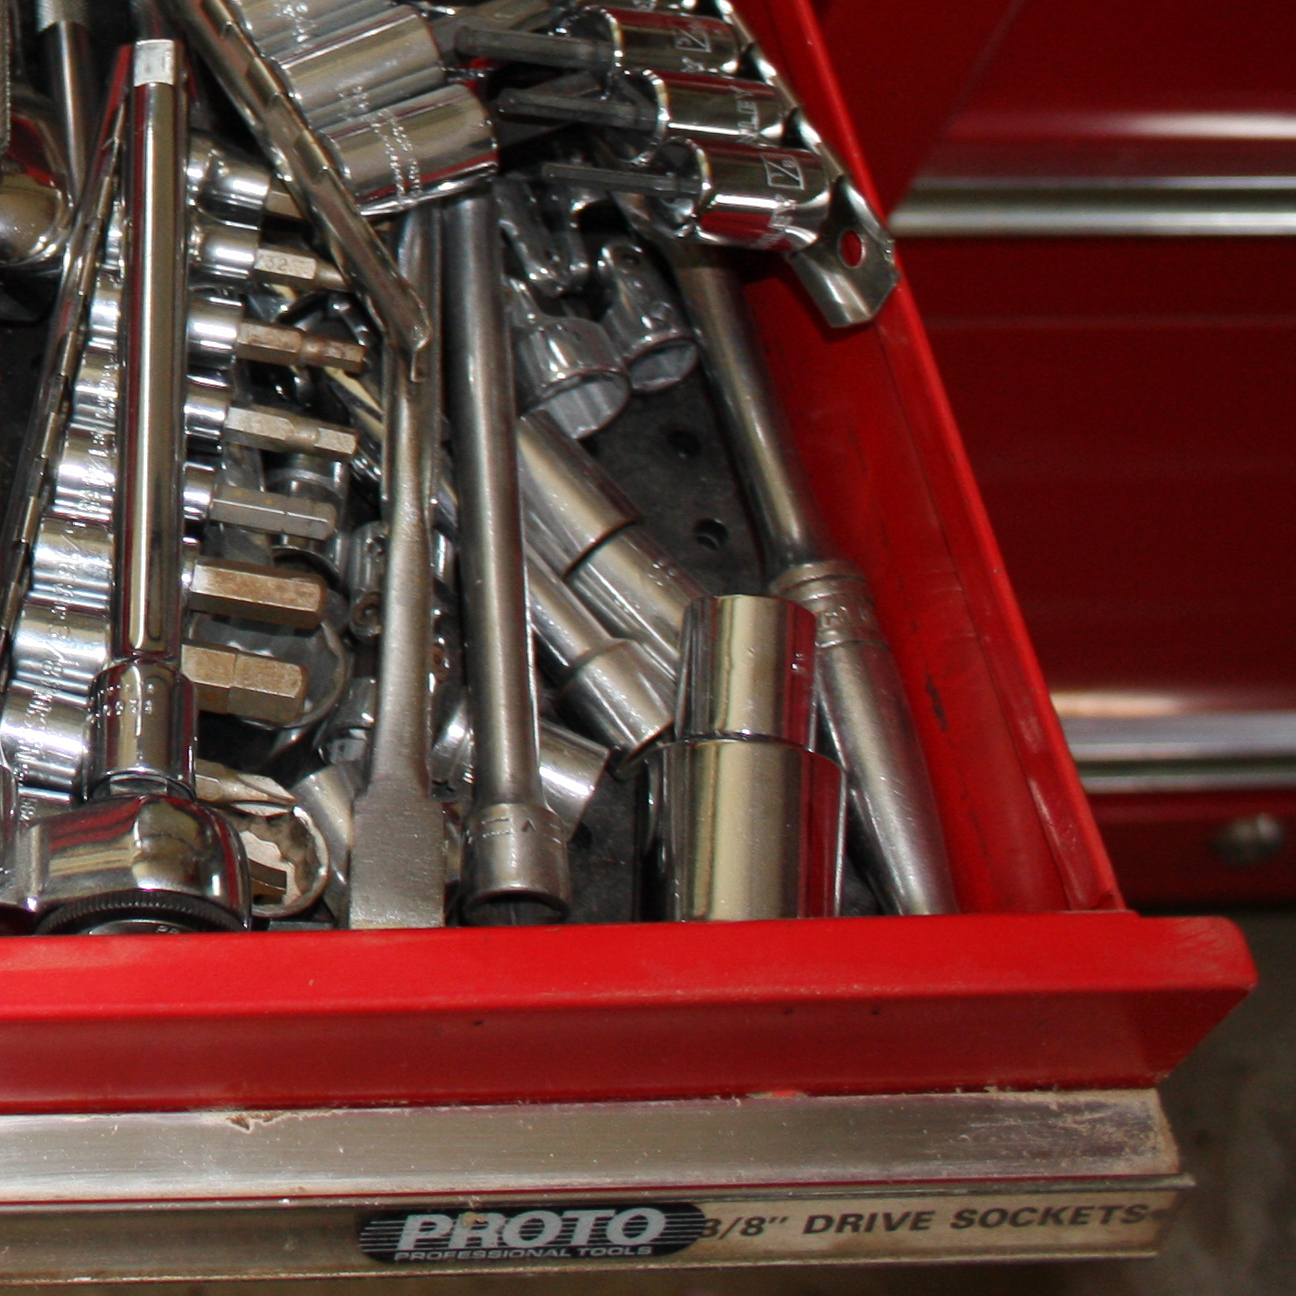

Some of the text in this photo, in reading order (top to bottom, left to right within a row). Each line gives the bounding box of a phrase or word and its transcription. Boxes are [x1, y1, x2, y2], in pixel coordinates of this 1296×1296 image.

[395, 1207, 666, 1251] PROTO
[802, 1210, 934, 1235] DRIVE
[949, 1204, 1149, 1230] SOCKETS
[394, 1244, 653, 1262] PROFESSIONAL TOOLS
